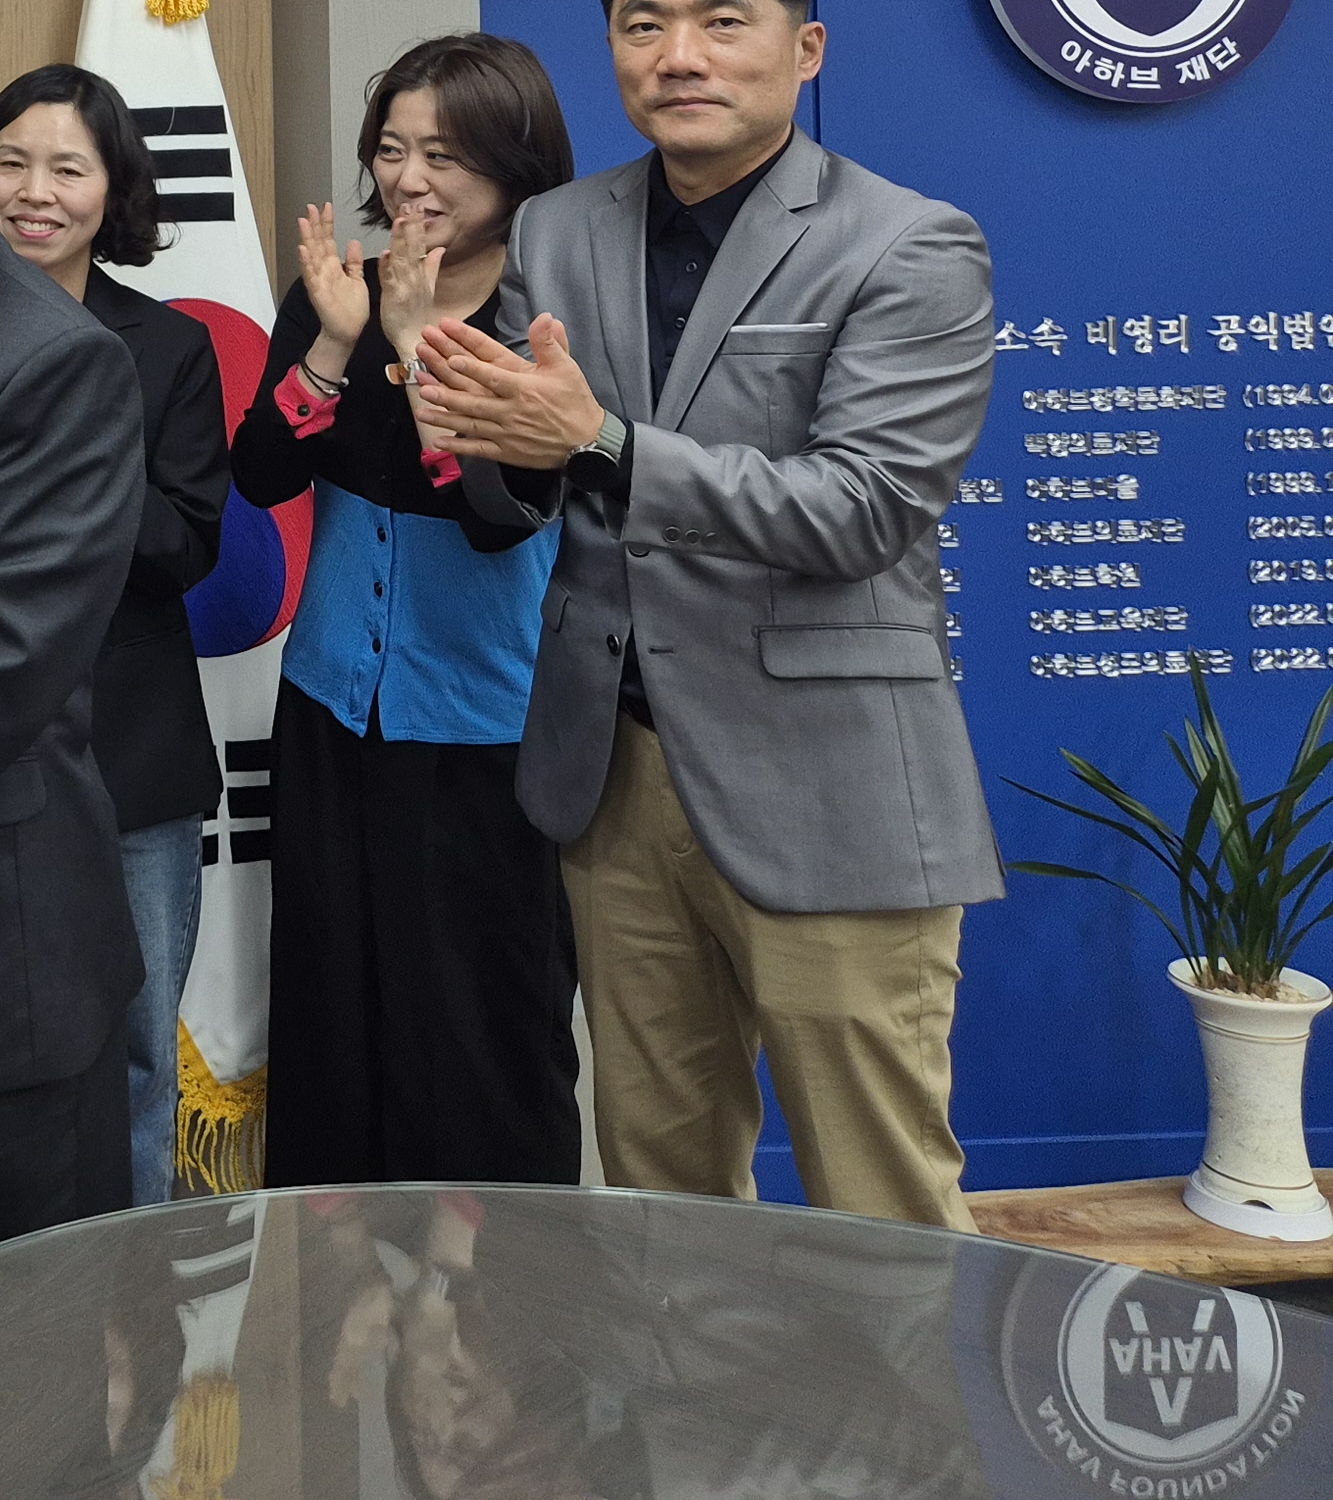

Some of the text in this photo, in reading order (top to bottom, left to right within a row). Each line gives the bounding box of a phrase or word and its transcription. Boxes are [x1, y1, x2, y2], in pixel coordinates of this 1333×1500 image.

[1060, 35, 1242, 90] 아하브 재단
[994, 315, 1068, 356] 소속
[1084, 313, 1191, 356] 비영리
